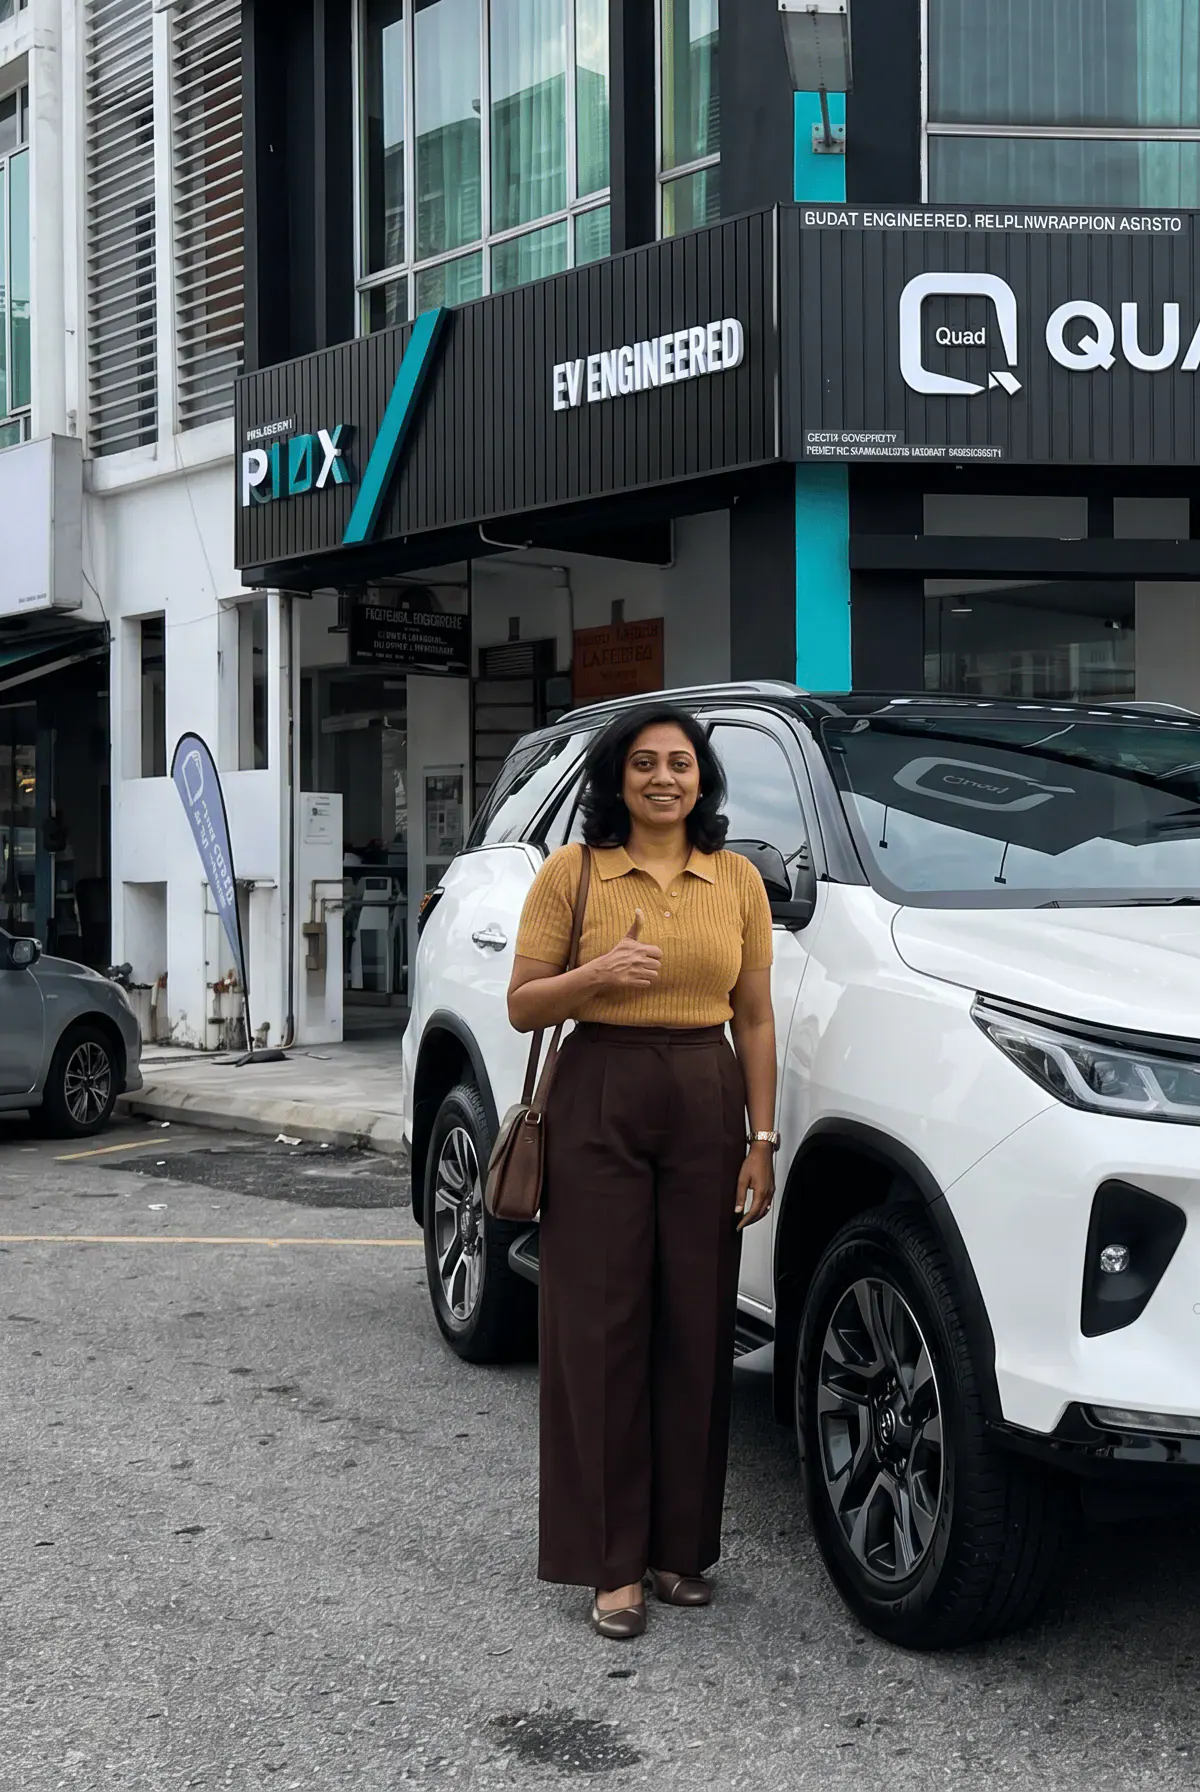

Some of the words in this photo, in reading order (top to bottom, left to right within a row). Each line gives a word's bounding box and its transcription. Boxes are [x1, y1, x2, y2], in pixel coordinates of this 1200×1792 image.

[863, 213, 972, 228] ENGINEERED.
[935, 326, 986, 346] Quad
[552, 357, 585, 412] EV
[586, 316, 745, 403] ENGINEERED
